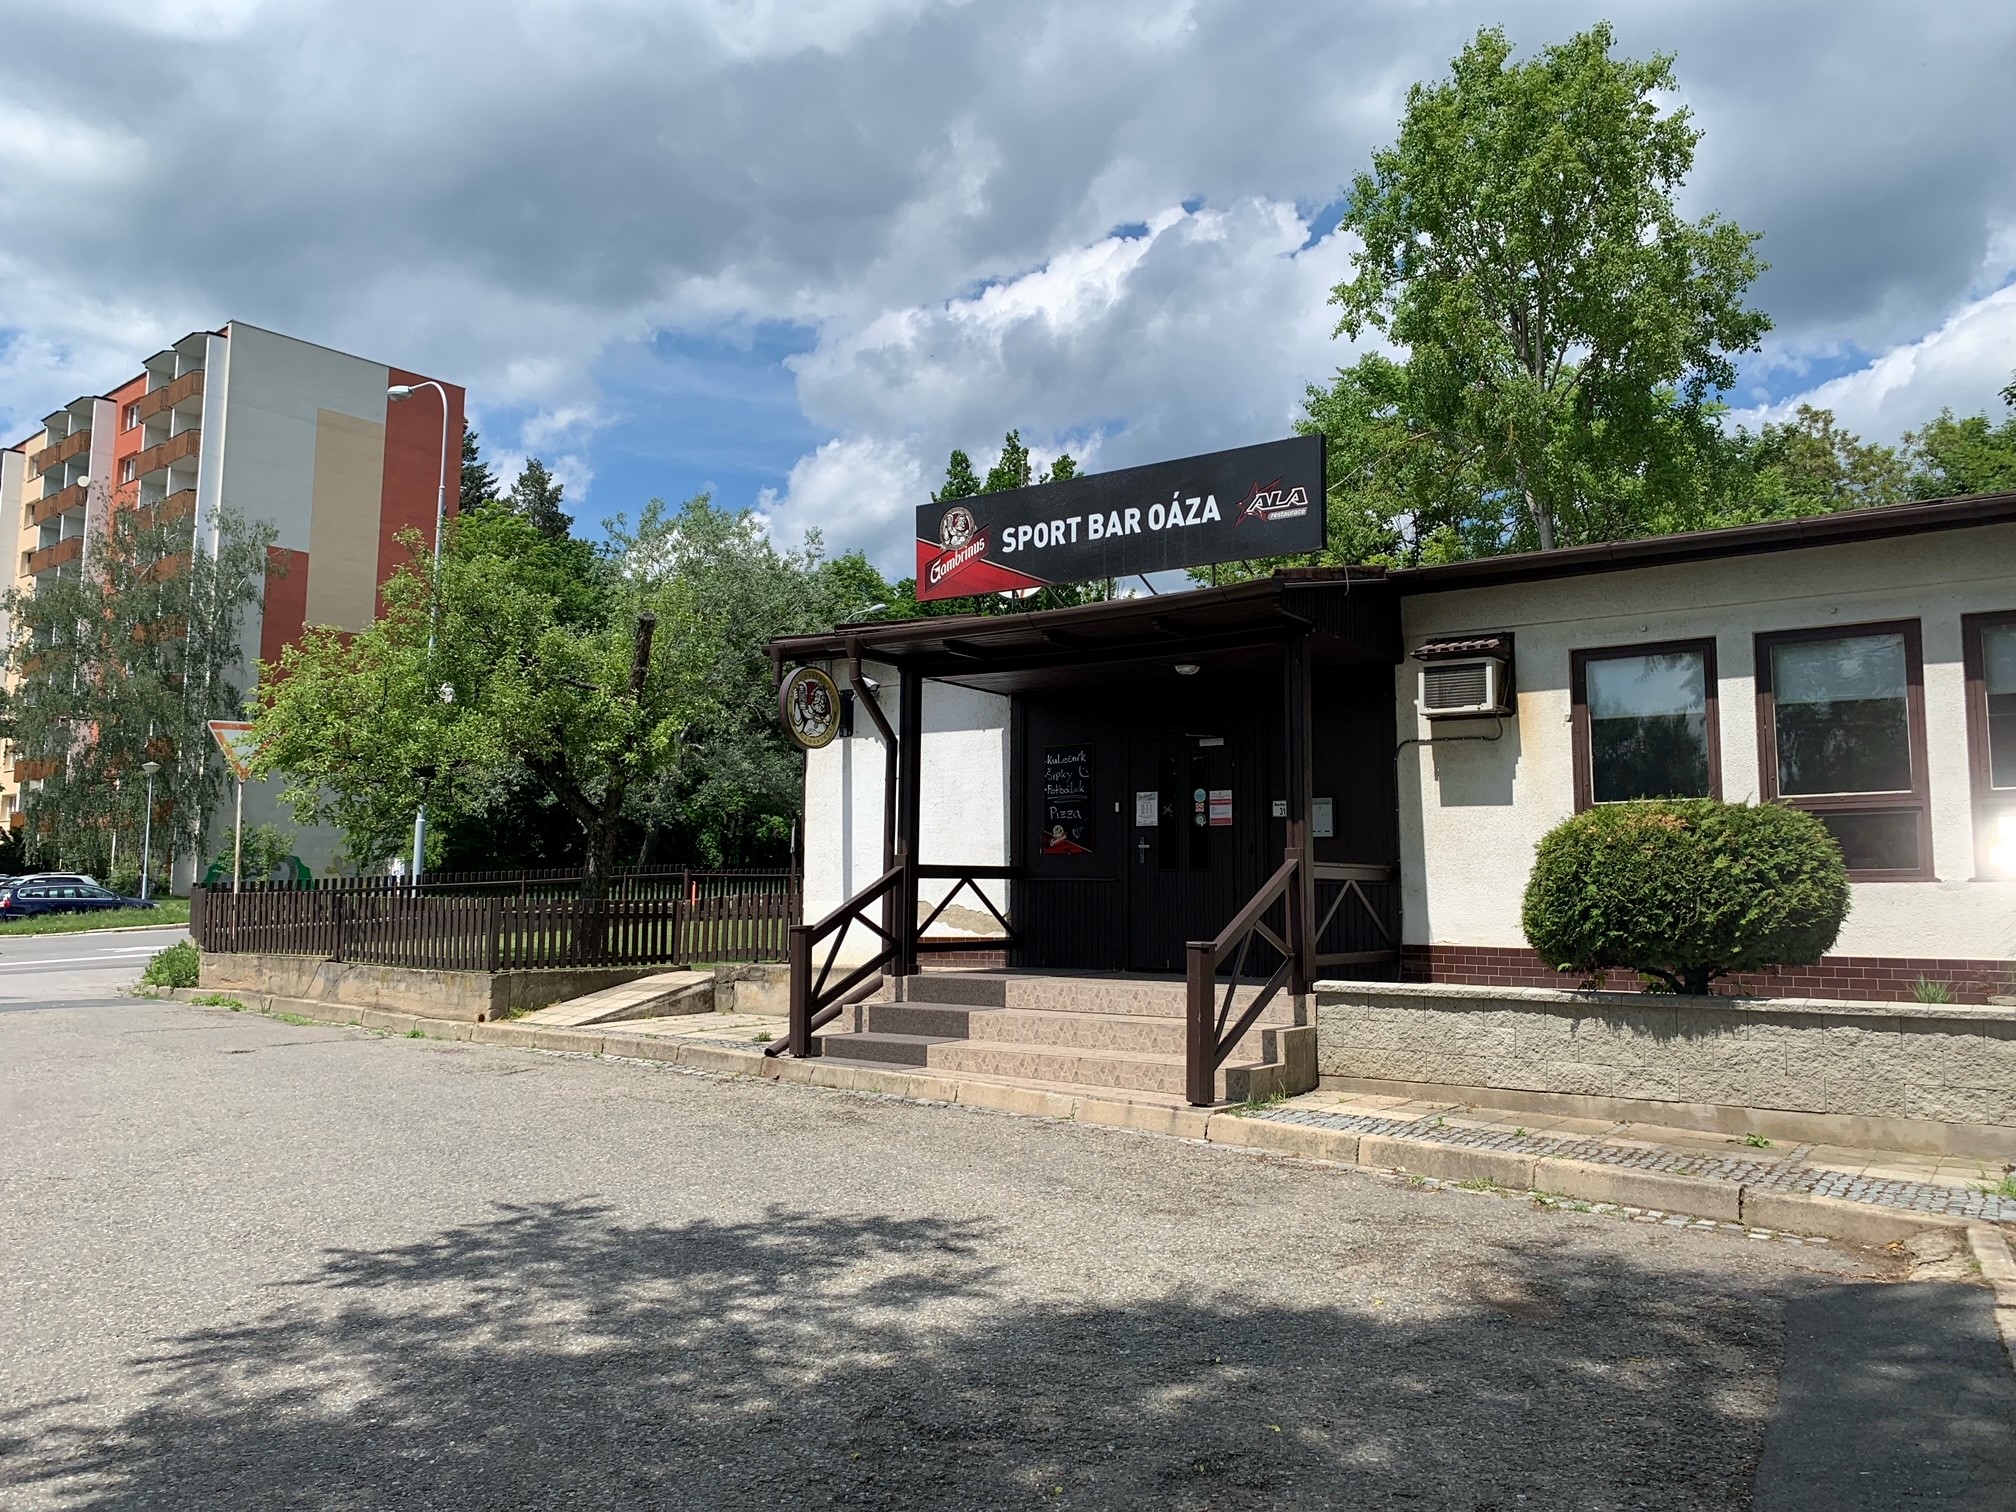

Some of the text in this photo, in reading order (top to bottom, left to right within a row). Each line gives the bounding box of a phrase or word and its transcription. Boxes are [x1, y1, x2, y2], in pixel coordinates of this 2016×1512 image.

[1246, 486, 1309, 512] ALA
[1001, 515, 1082, 553] SPORT
[1088, 507, 1141, 541] BAR
[1147, 490, 1221, 531] OÁZA
[1269, 507, 1307, 520] restaurace
[930, 537, 985, 584] Gambrinus
[1049, 806, 1082, 820] Pizza
